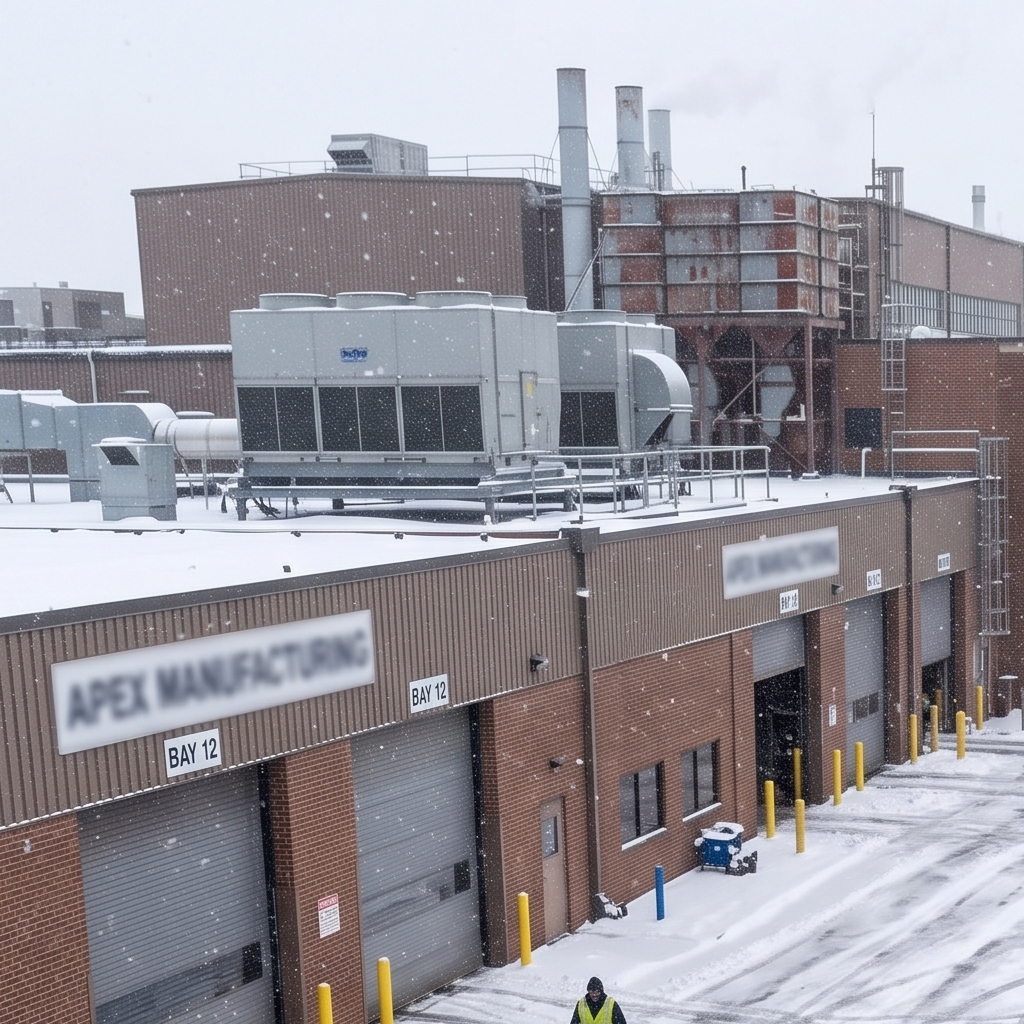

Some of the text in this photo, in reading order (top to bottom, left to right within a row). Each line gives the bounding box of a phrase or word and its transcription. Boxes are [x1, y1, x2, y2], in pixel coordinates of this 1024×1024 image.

[66, 629, 370, 731] APEX MANUFACTURING
[412, 681, 447, 707] BAY 12
[169, 737, 218, 769] BAY 12
